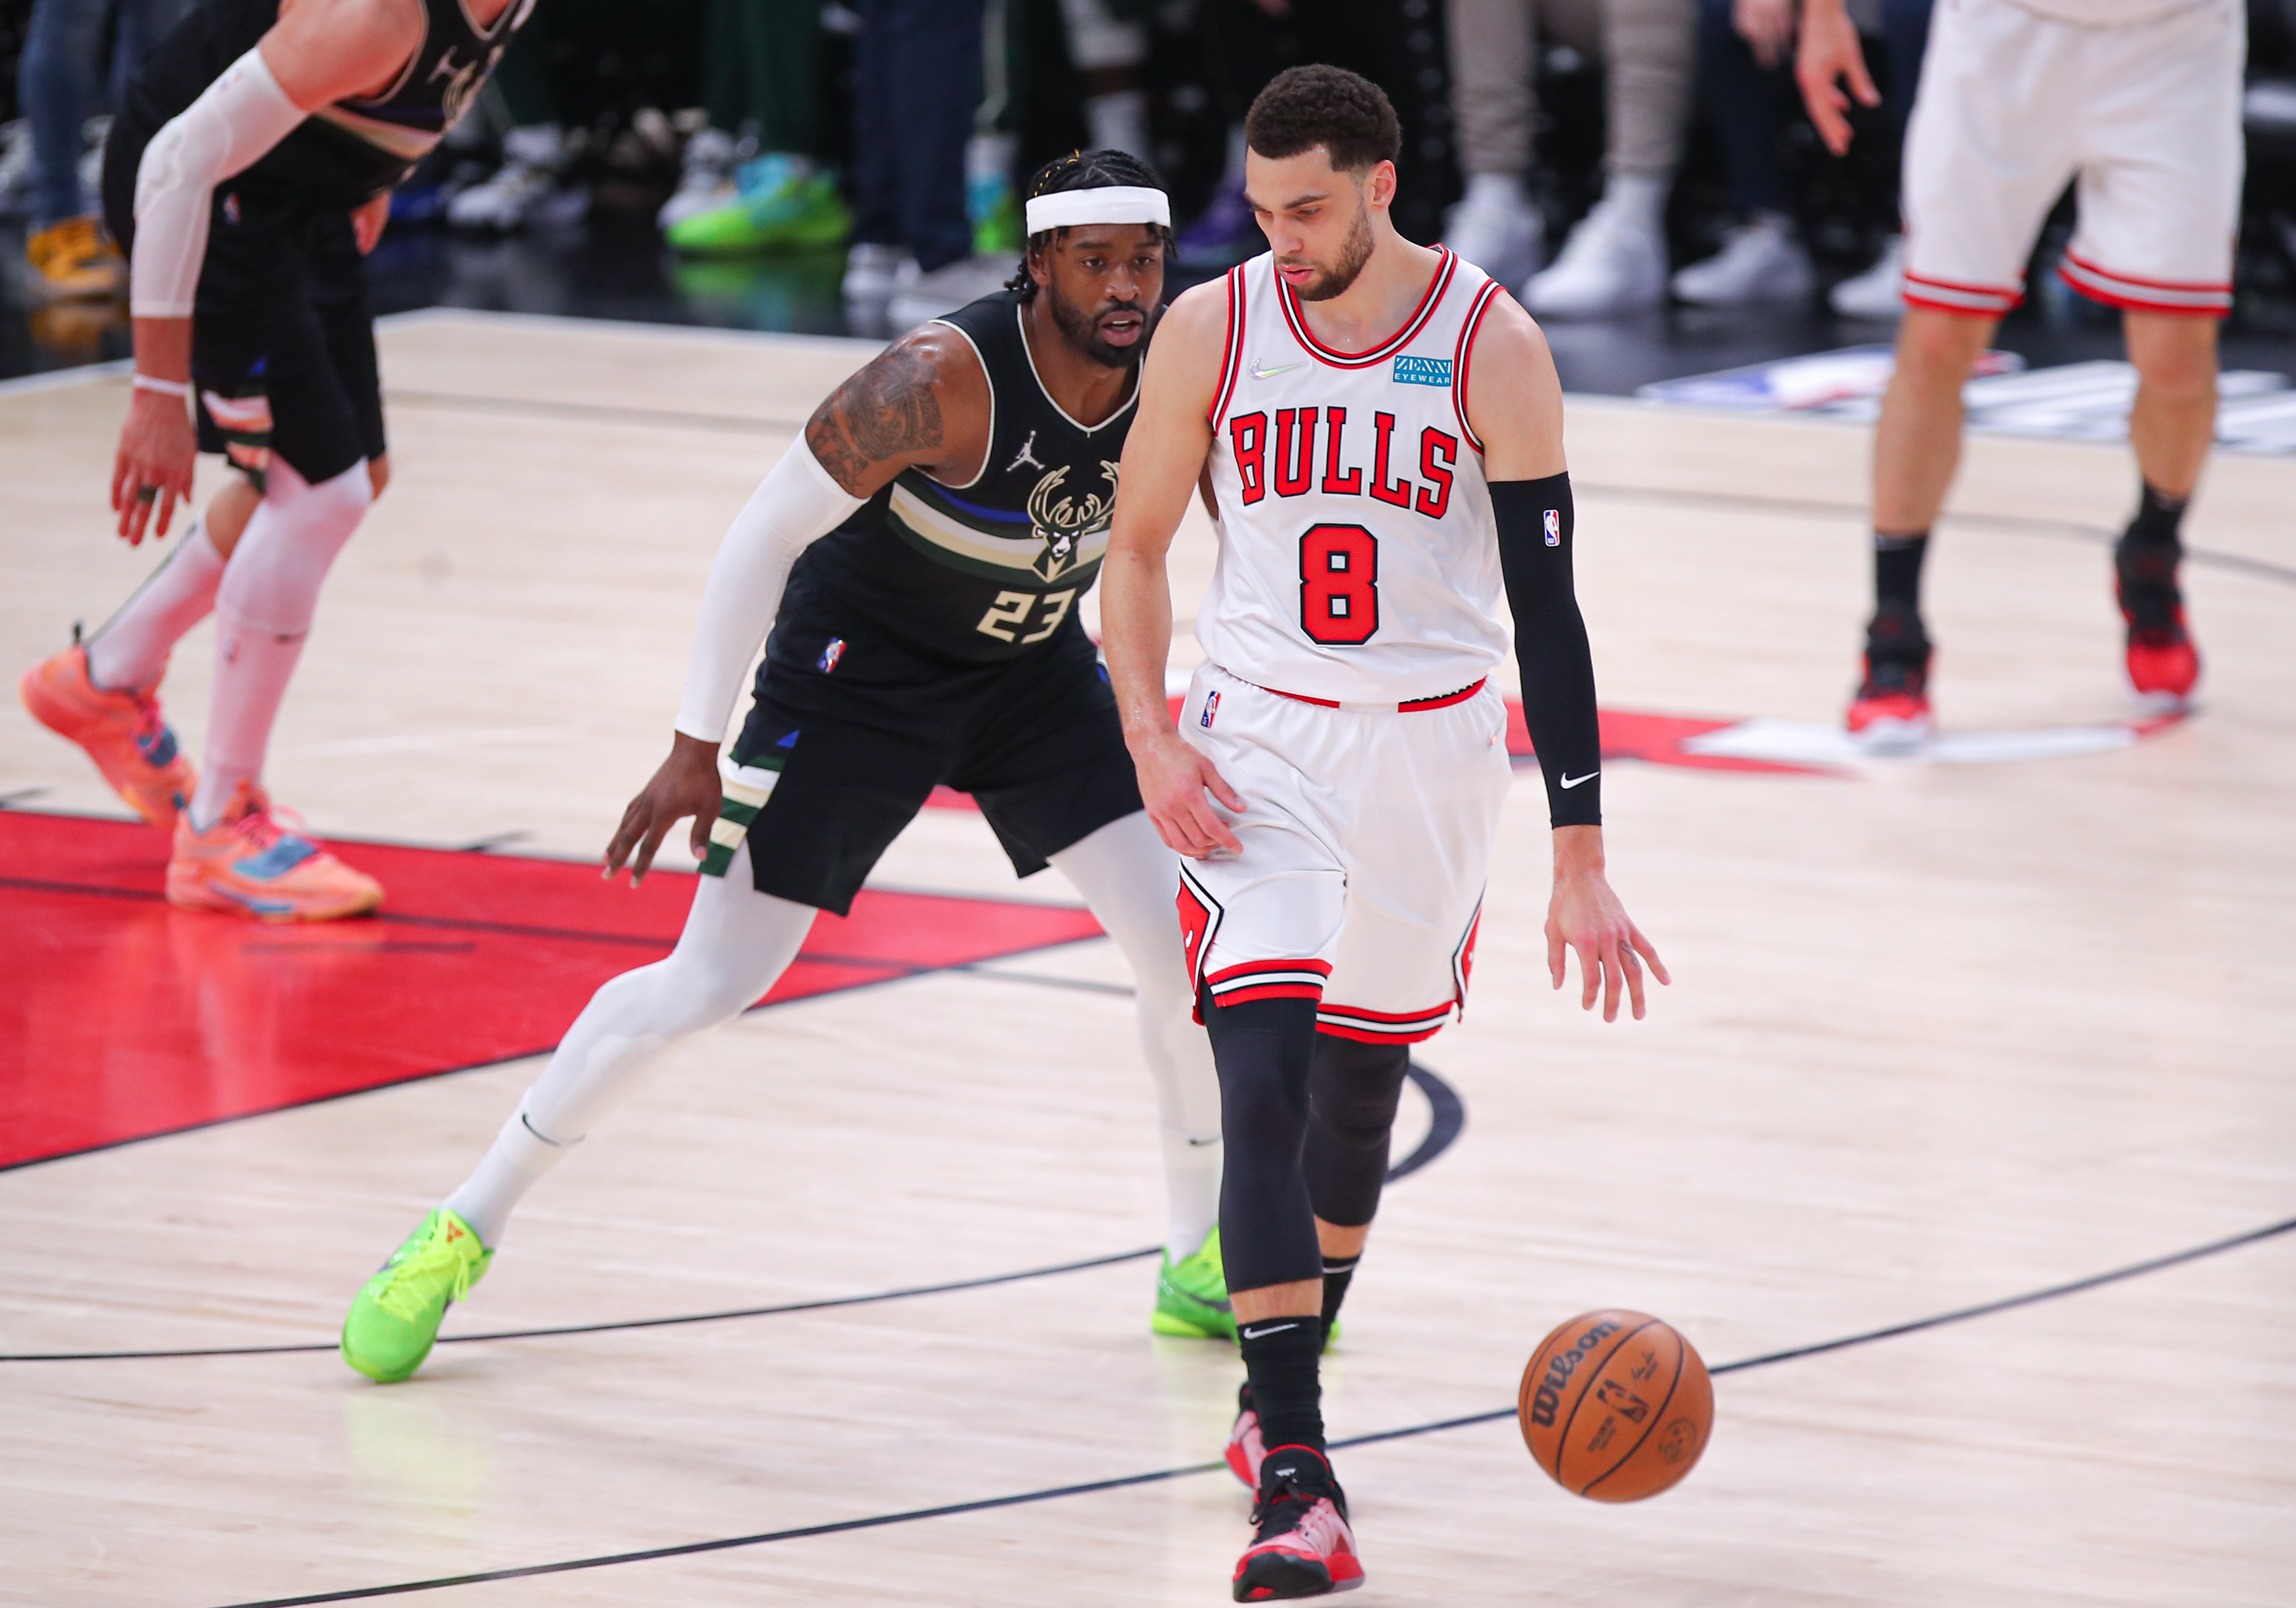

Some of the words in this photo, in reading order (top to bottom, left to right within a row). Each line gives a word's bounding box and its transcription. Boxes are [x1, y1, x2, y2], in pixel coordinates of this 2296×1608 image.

[1394, 373, 1450, 384] EYEWEAR
[1396, 358, 1451, 374] ZENNI
[1230, 406, 1458, 519] BULLS
[976, 587, 1076, 644] 23
[1300, 523, 1379, 644] 8
[1531, 1321, 1621, 1427] Wilson
